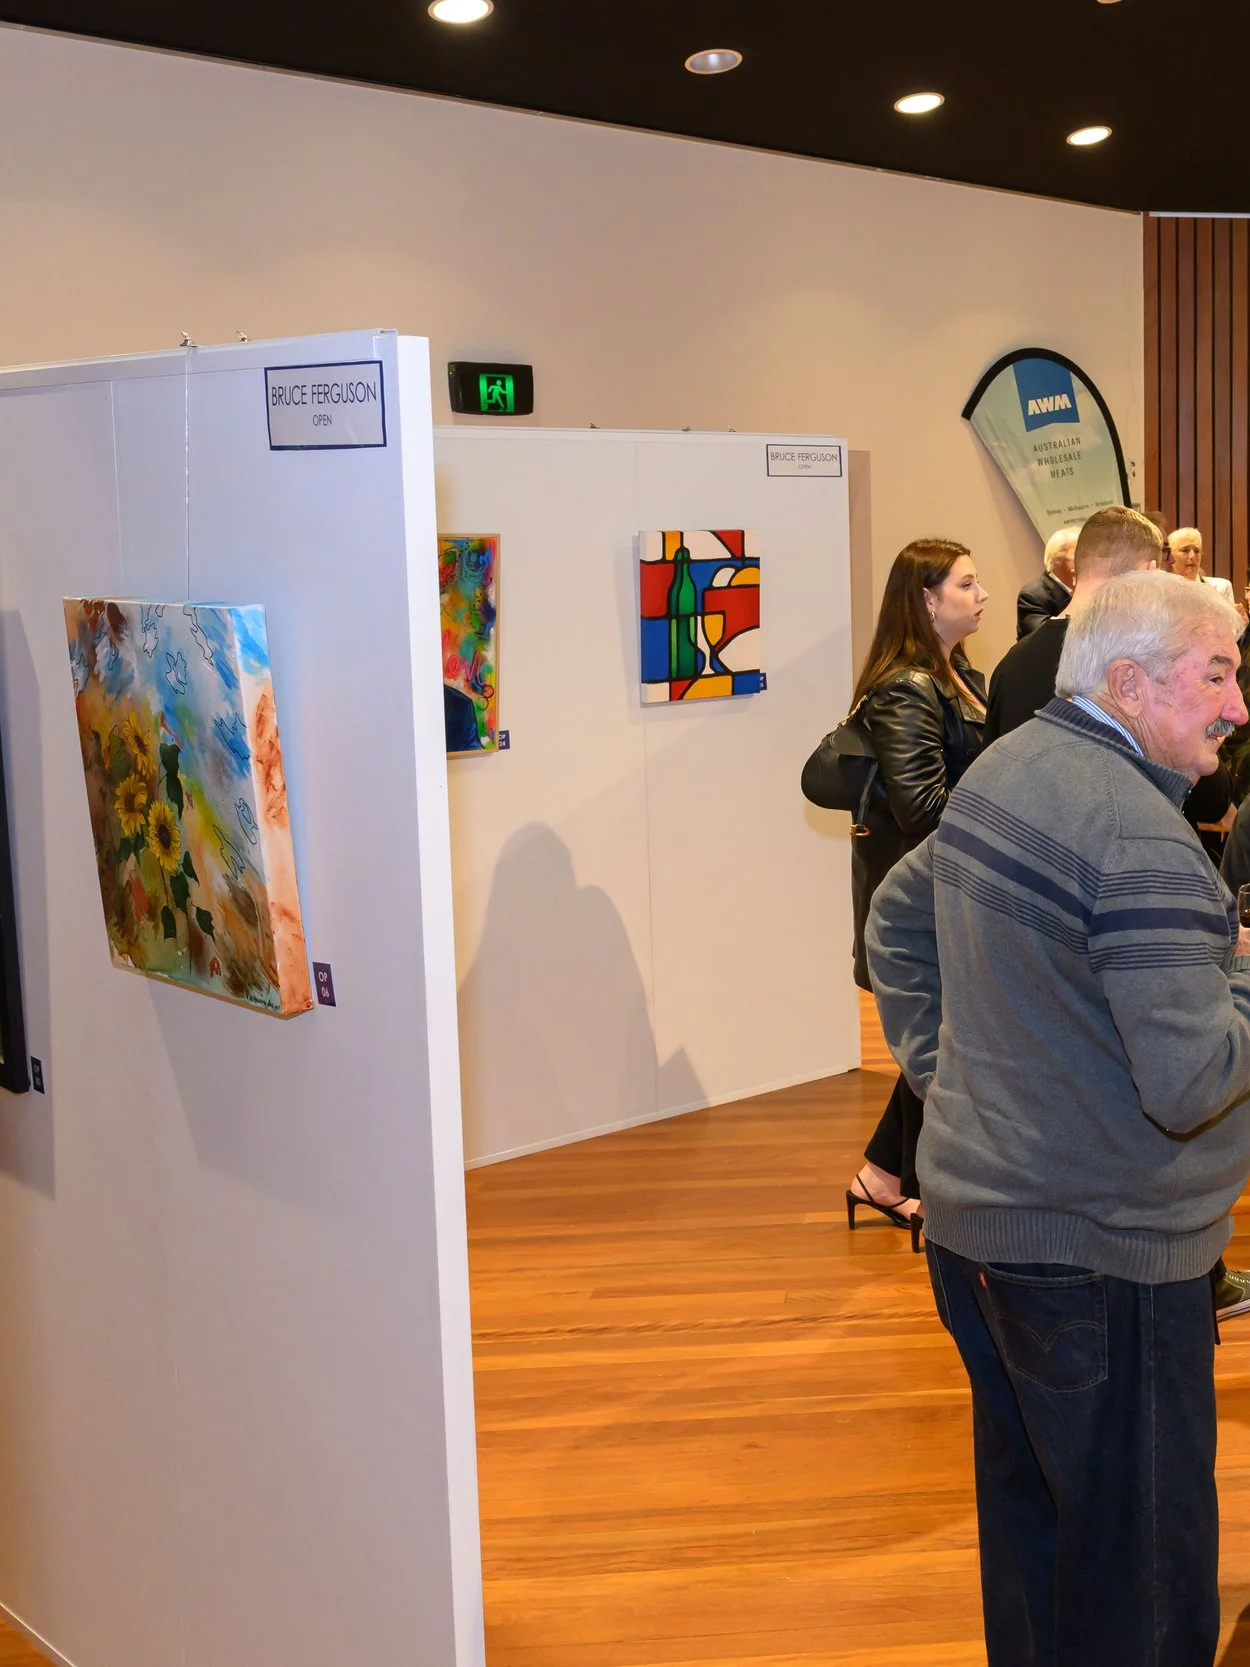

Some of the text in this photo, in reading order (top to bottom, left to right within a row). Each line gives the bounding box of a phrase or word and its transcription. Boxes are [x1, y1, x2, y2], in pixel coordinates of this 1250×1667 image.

[272, 381, 377, 406] BRUCE FERGUSON
[1028, 394, 1072, 416] AWM
[312, 414, 333, 426] OPEN
[1033, 436, 1081, 453] AUSTRALIAN
[770, 452, 838, 462] BRUCE FERGUSON
[1036, 451, 1082, 467] WHOLESALE
[1050, 467, 1075, 479] MEATS
[318, 971, 328, 982] OP
